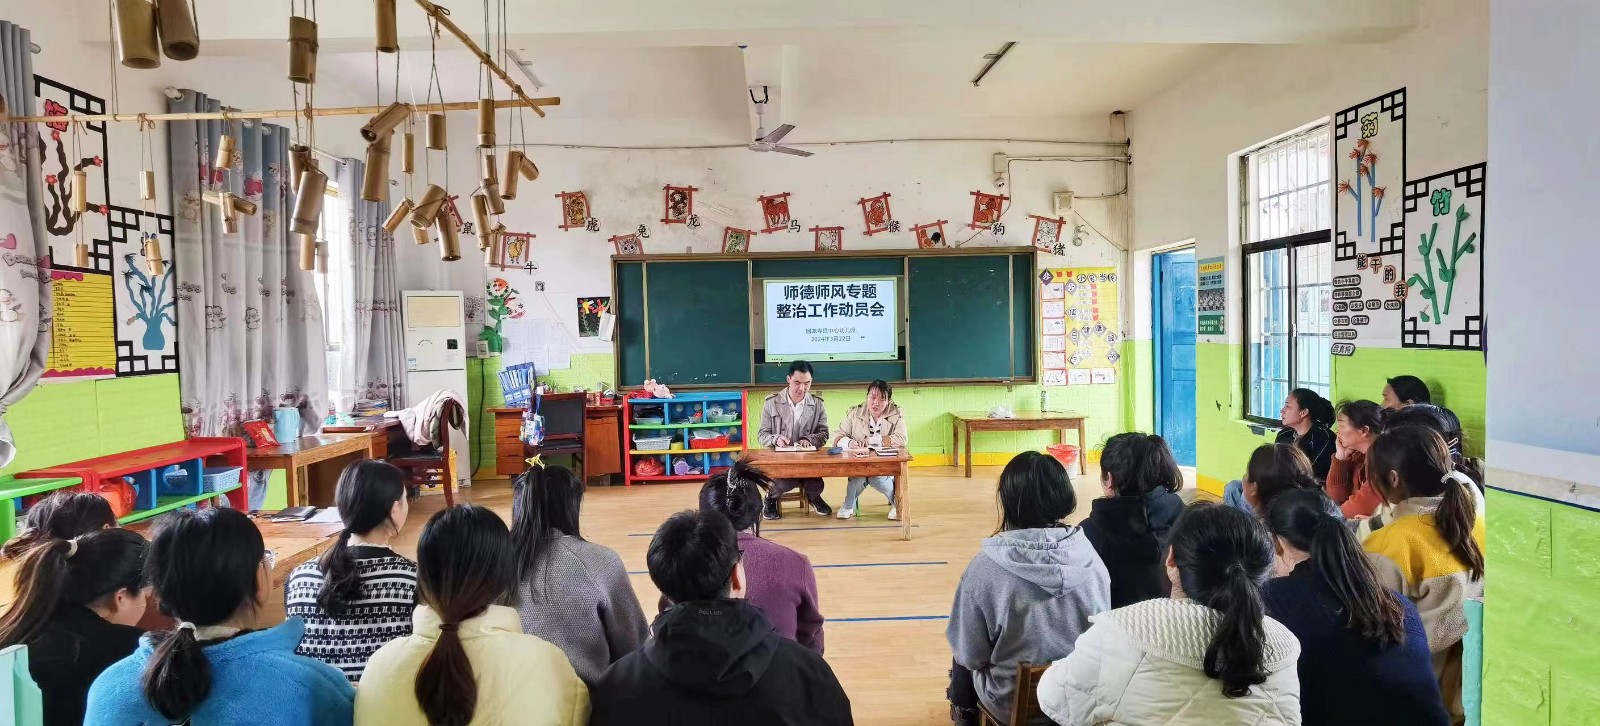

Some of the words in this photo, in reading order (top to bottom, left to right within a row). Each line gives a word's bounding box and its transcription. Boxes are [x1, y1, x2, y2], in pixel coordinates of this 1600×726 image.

[1360, 112, 1379, 139] 菊
[1431, 188, 1451, 216] 竹
[461, 222, 475, 236] 鼠
[586, 217, 601, 232] 虎
[687, 214, 701, 229] 龙
[788, 219, 802, 233] 马
[888, 219, 901, 233] 猴
[992, 222, 1005, 236] 狗
[636, 225, 650, 239] 兔
[1053, 243, 1066, 257] 猪
[523, 260, 538, 275] 牛
[1357, 254, 1406, 298] 能干的我
[783, 283, 877, 301] 师德师风专题
[776, 301, 885, 319] 整治工作动员会
[810, 335, 852, 343] 2024年3月22日
